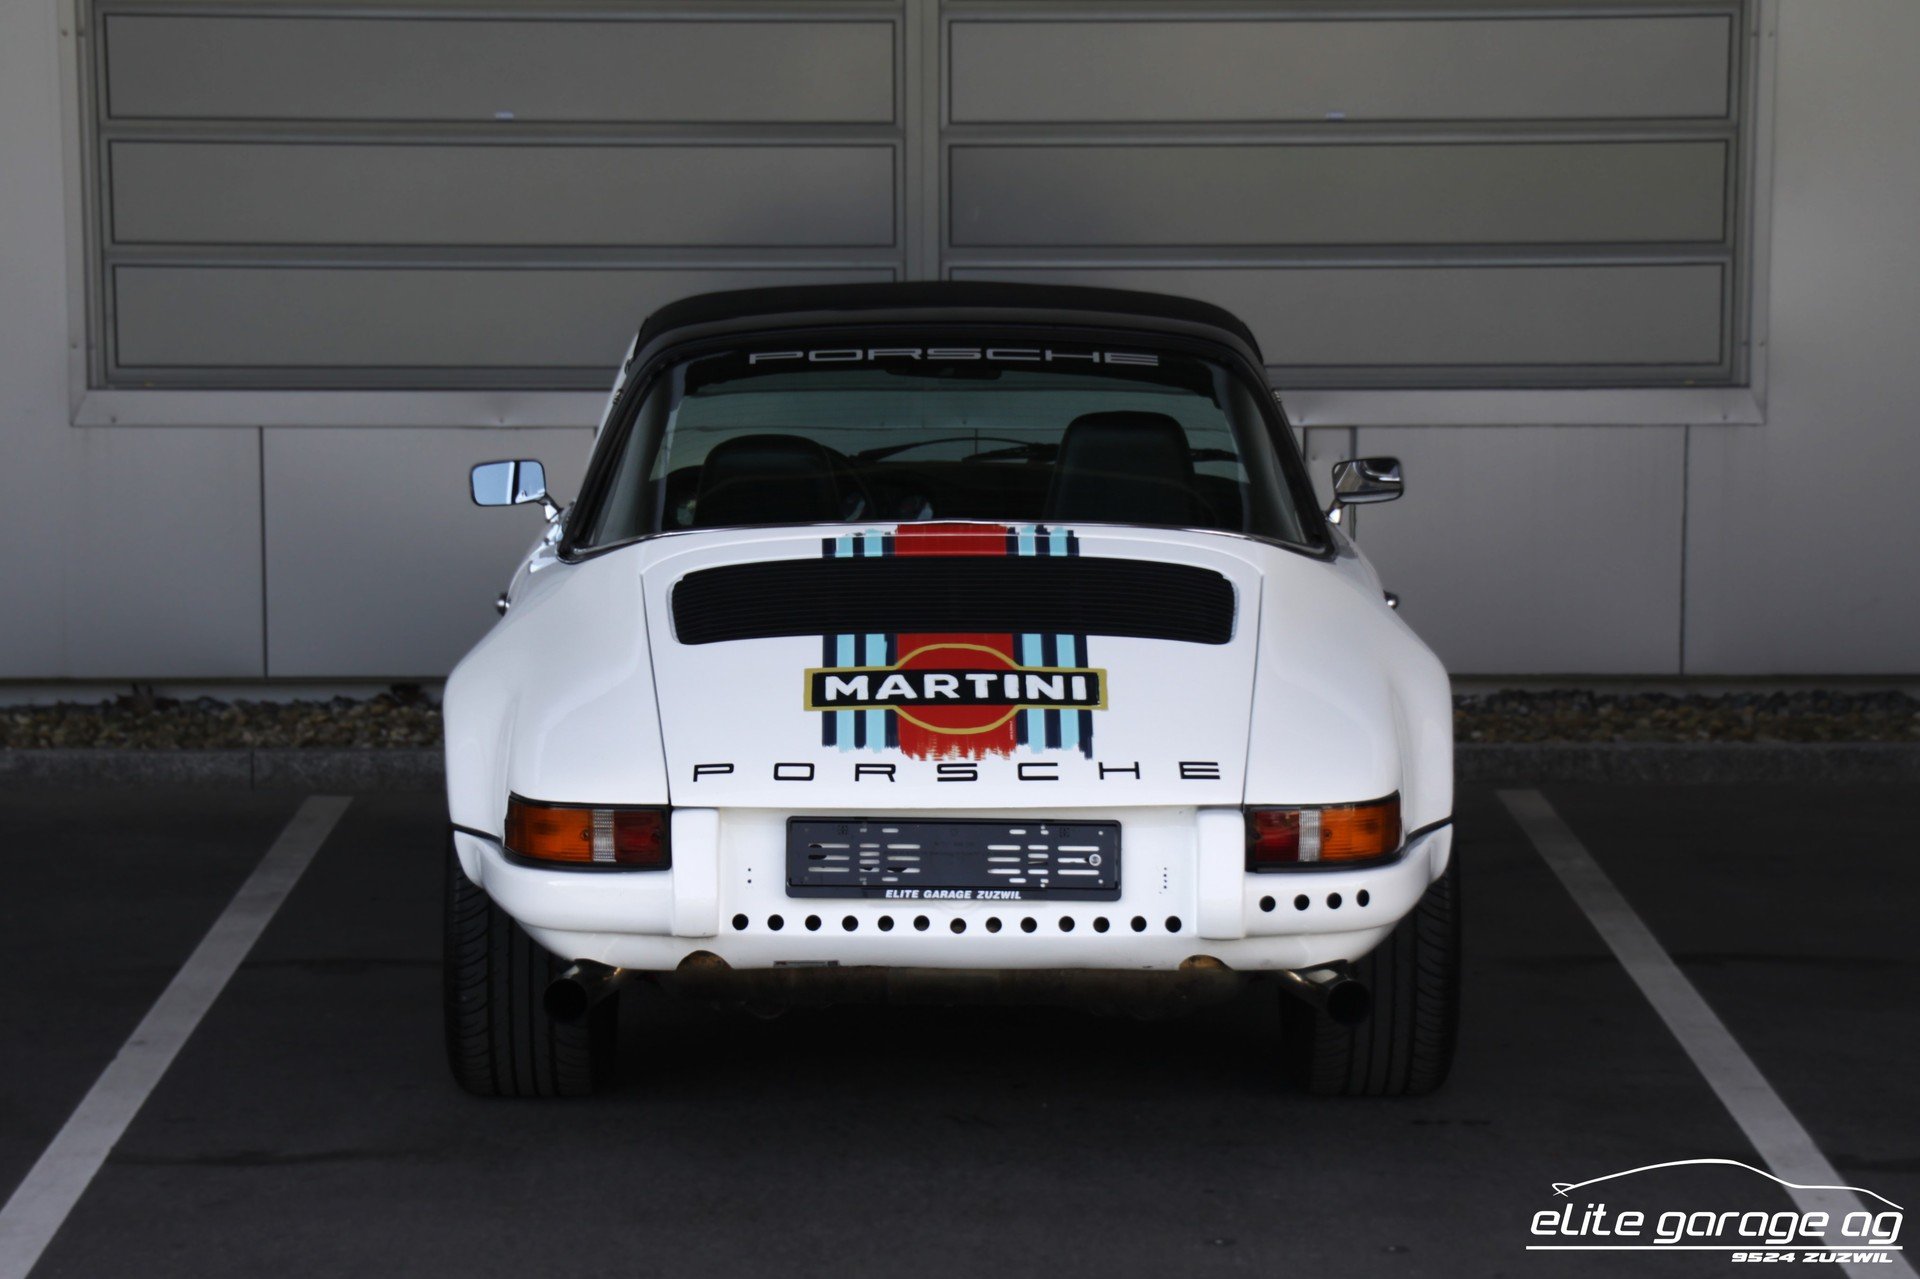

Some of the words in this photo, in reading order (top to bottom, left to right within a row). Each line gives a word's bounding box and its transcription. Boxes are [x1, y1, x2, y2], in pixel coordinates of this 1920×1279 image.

[749, 347, 1159, 366] PORSCHE
[823, 673, 1087, 701] MARTINI
[692, 761, 1221, 783] PORSCHE
[885, 888, 920, 899] ELITE
[923, 889, 972, 900] GARAGE
[976, 890, 1022, 901] ZUZWIL
